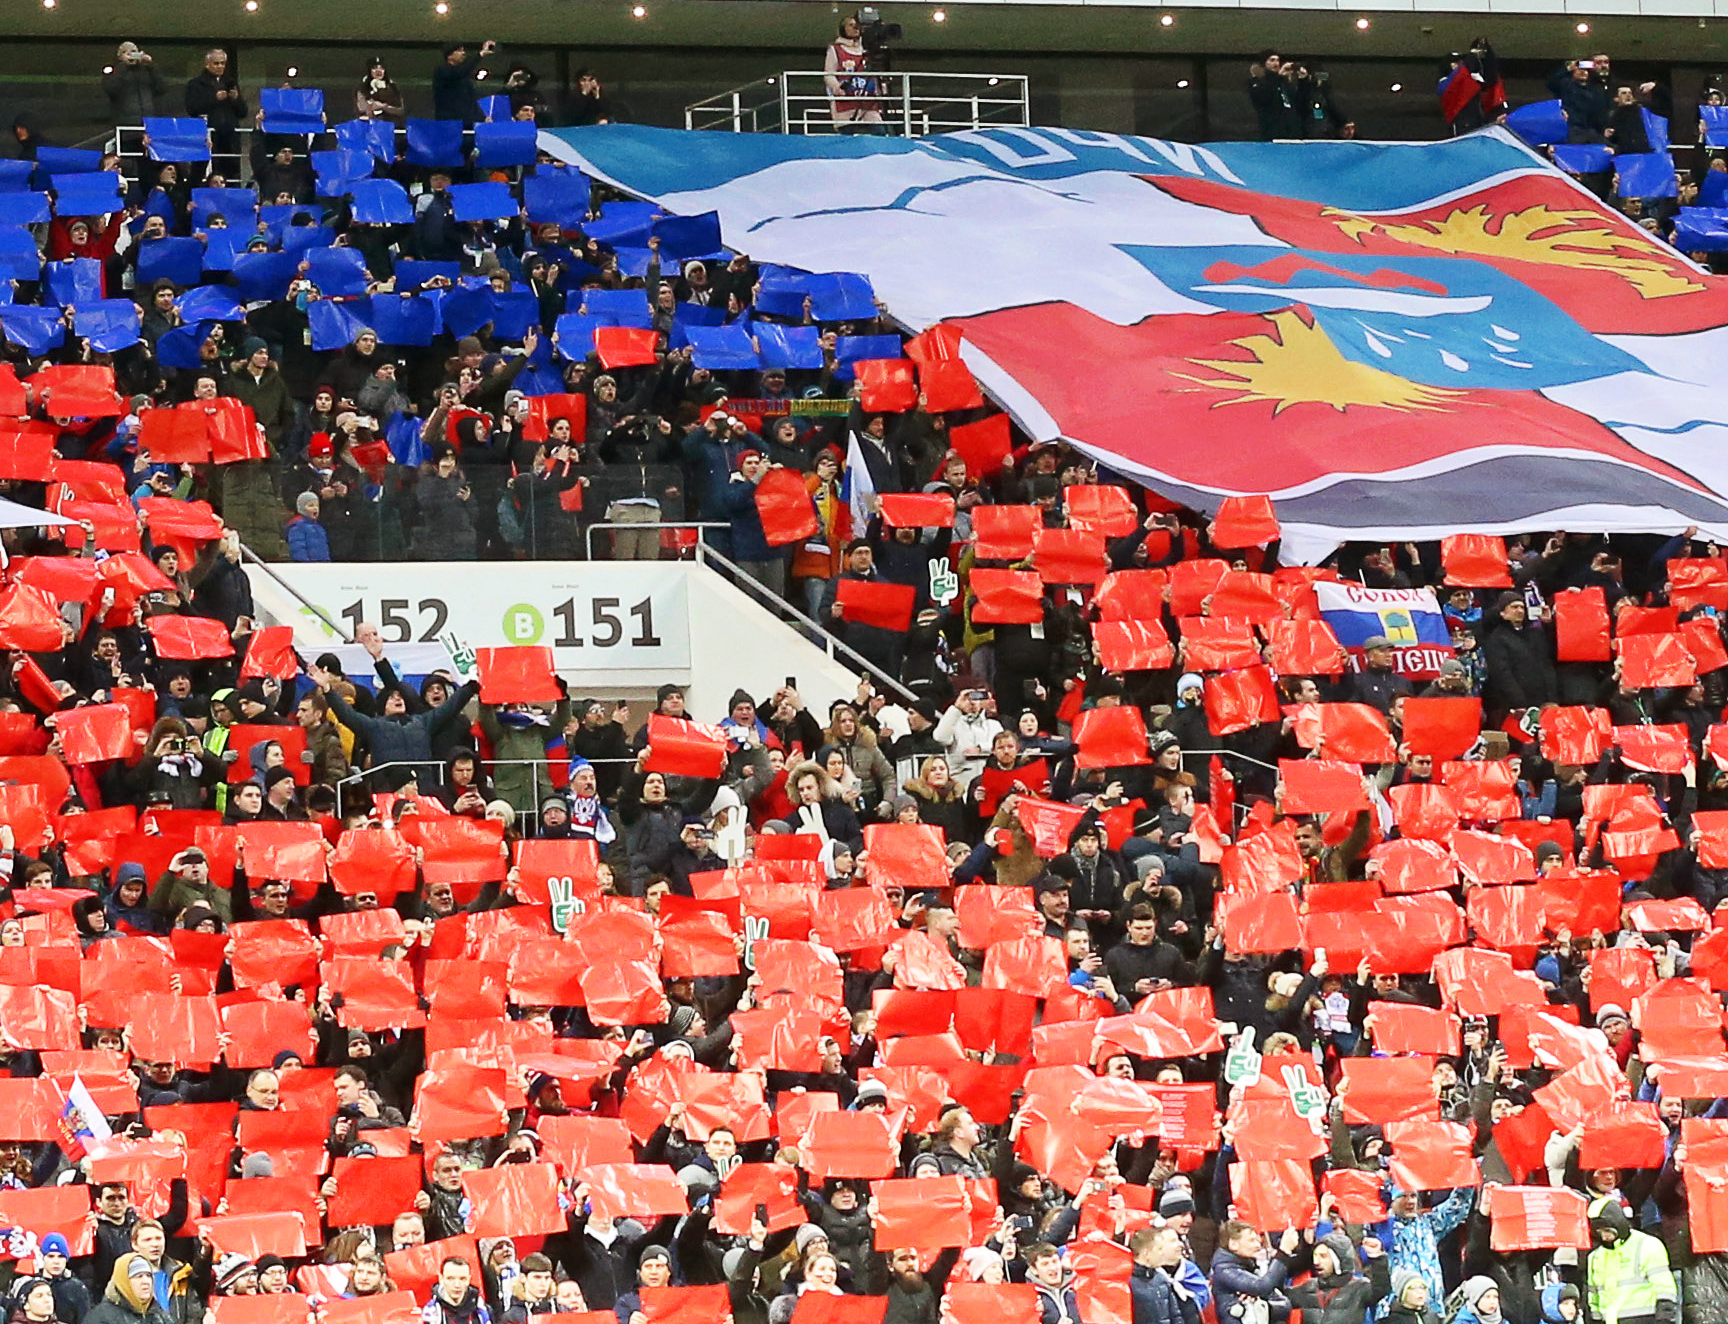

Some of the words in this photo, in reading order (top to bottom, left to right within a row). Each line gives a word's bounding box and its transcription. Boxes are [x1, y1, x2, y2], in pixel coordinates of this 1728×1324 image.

[914, 127, 1248, 187] ОЧИ
[342, 598, 448, 644] 152
[553, 596, 661, 647] 151
